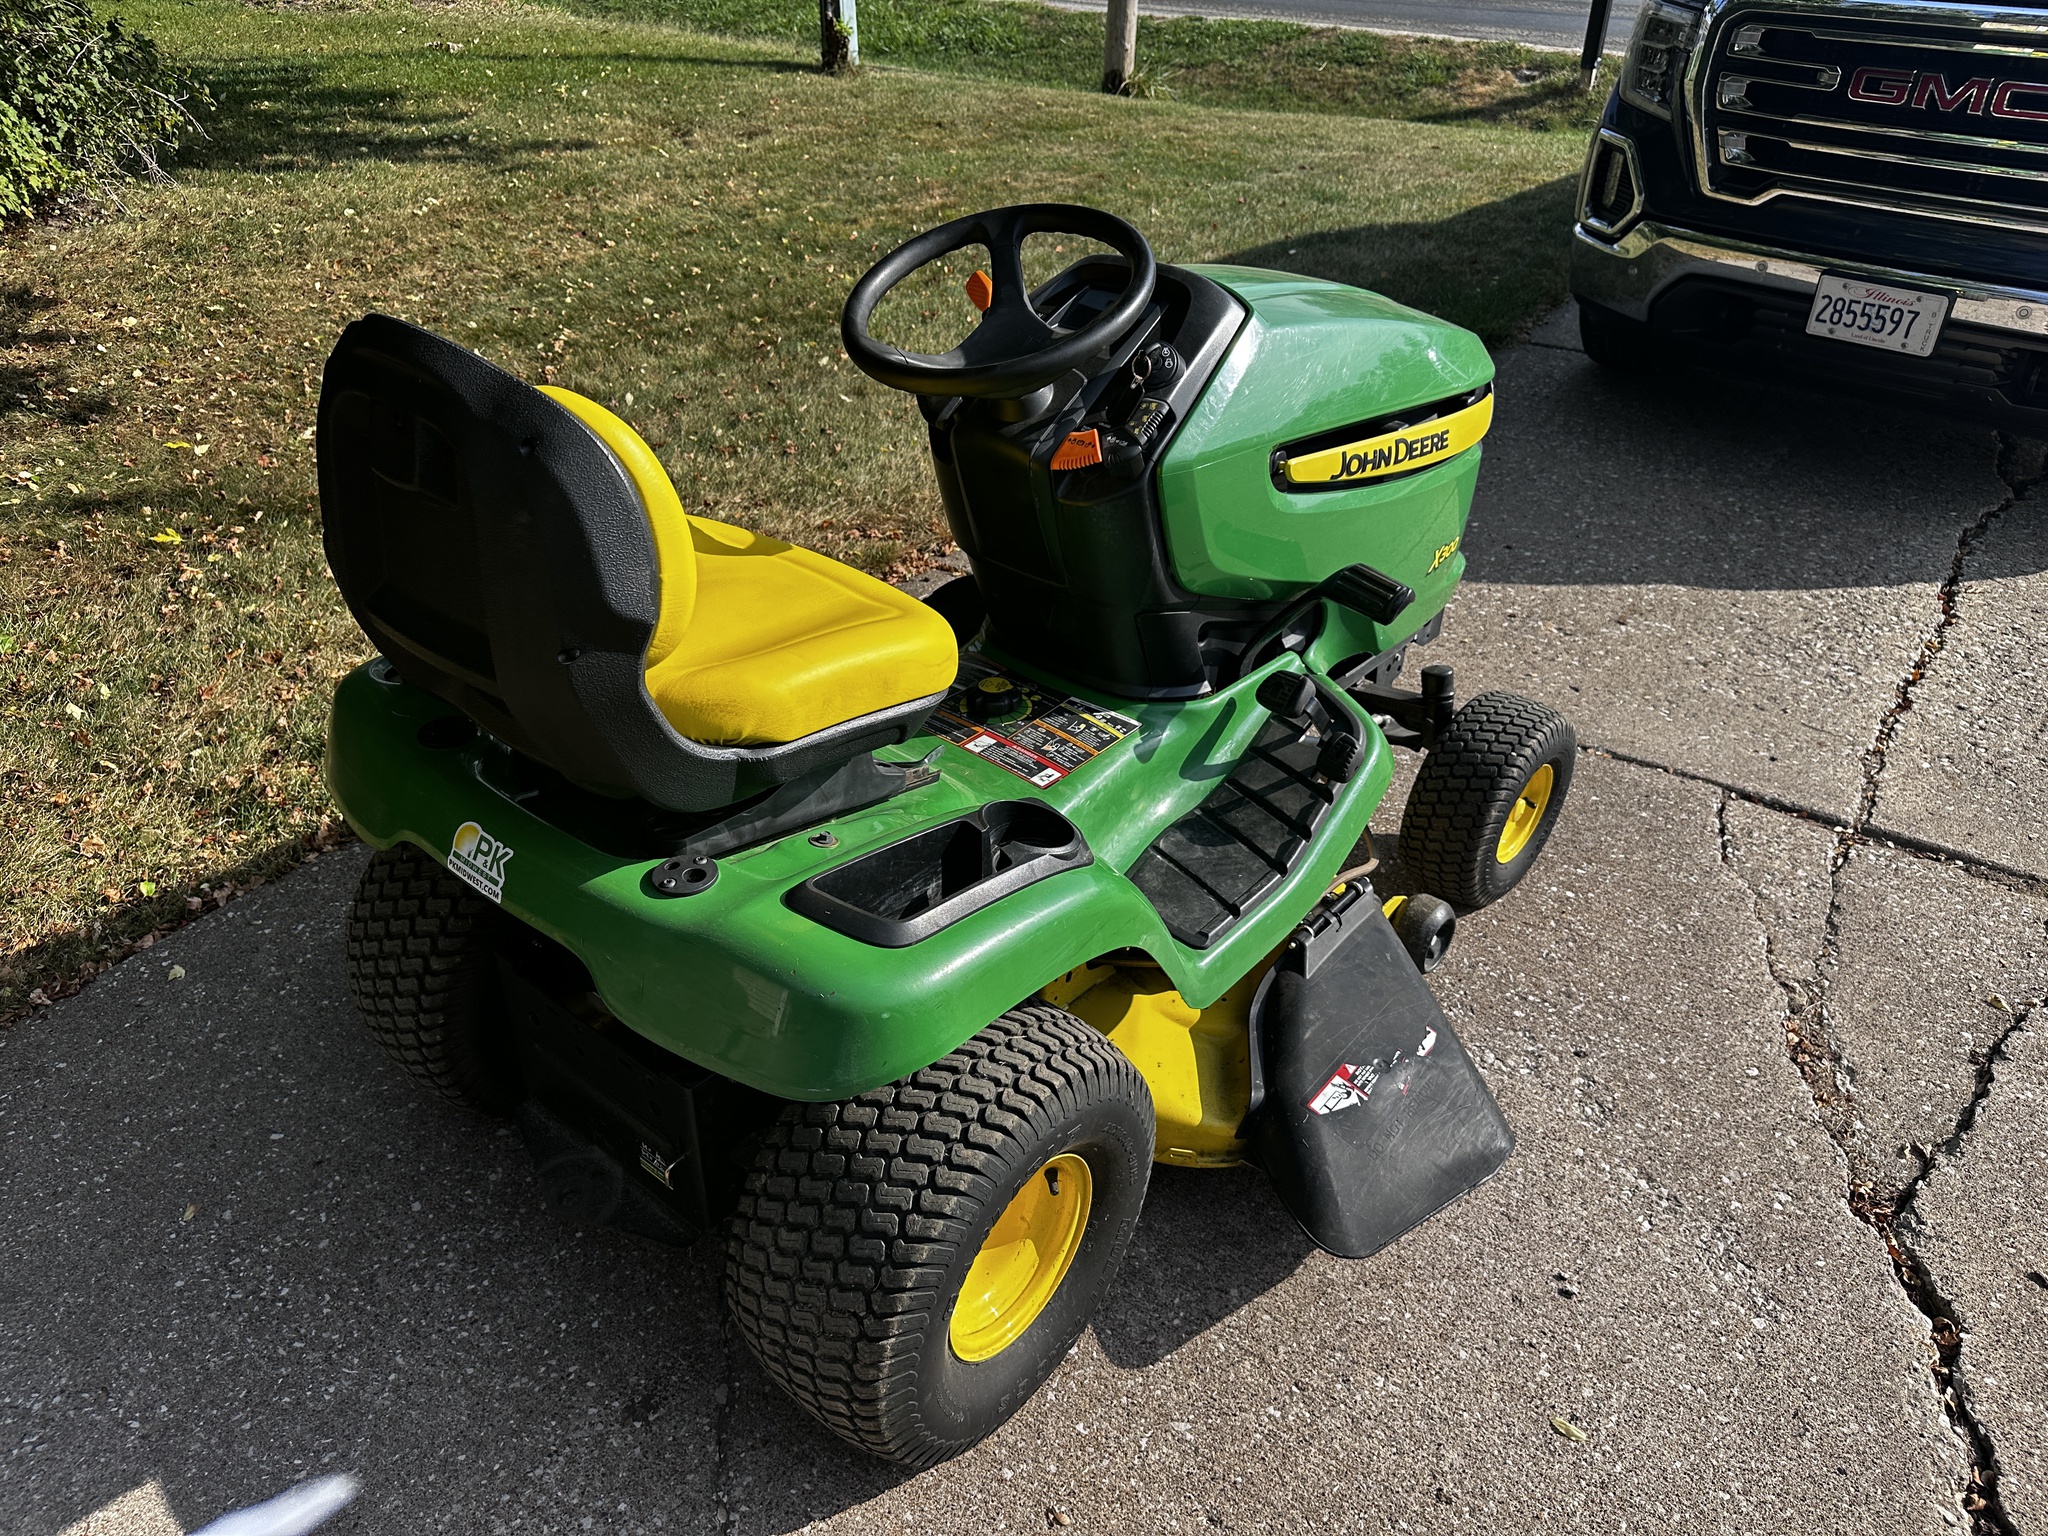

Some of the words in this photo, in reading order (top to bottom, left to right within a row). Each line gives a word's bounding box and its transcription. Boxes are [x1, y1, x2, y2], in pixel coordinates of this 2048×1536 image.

[1848, 66, 2048, 121] GMC
[1815, 294, 1920, 339] 2855597
[1848, 286, 1915, 307] Illinois
[1920, 323, 1935, 352] TRUCK
[1330, 446, 1392, 480] JOHN
[1393, 429, 1449, 465] DEERE
[1425, 536, 1459, 577] X300
[449, 859, 500, 900] PKMIDWEST.COM
[460, 856, 491, 880] MIDWEST
